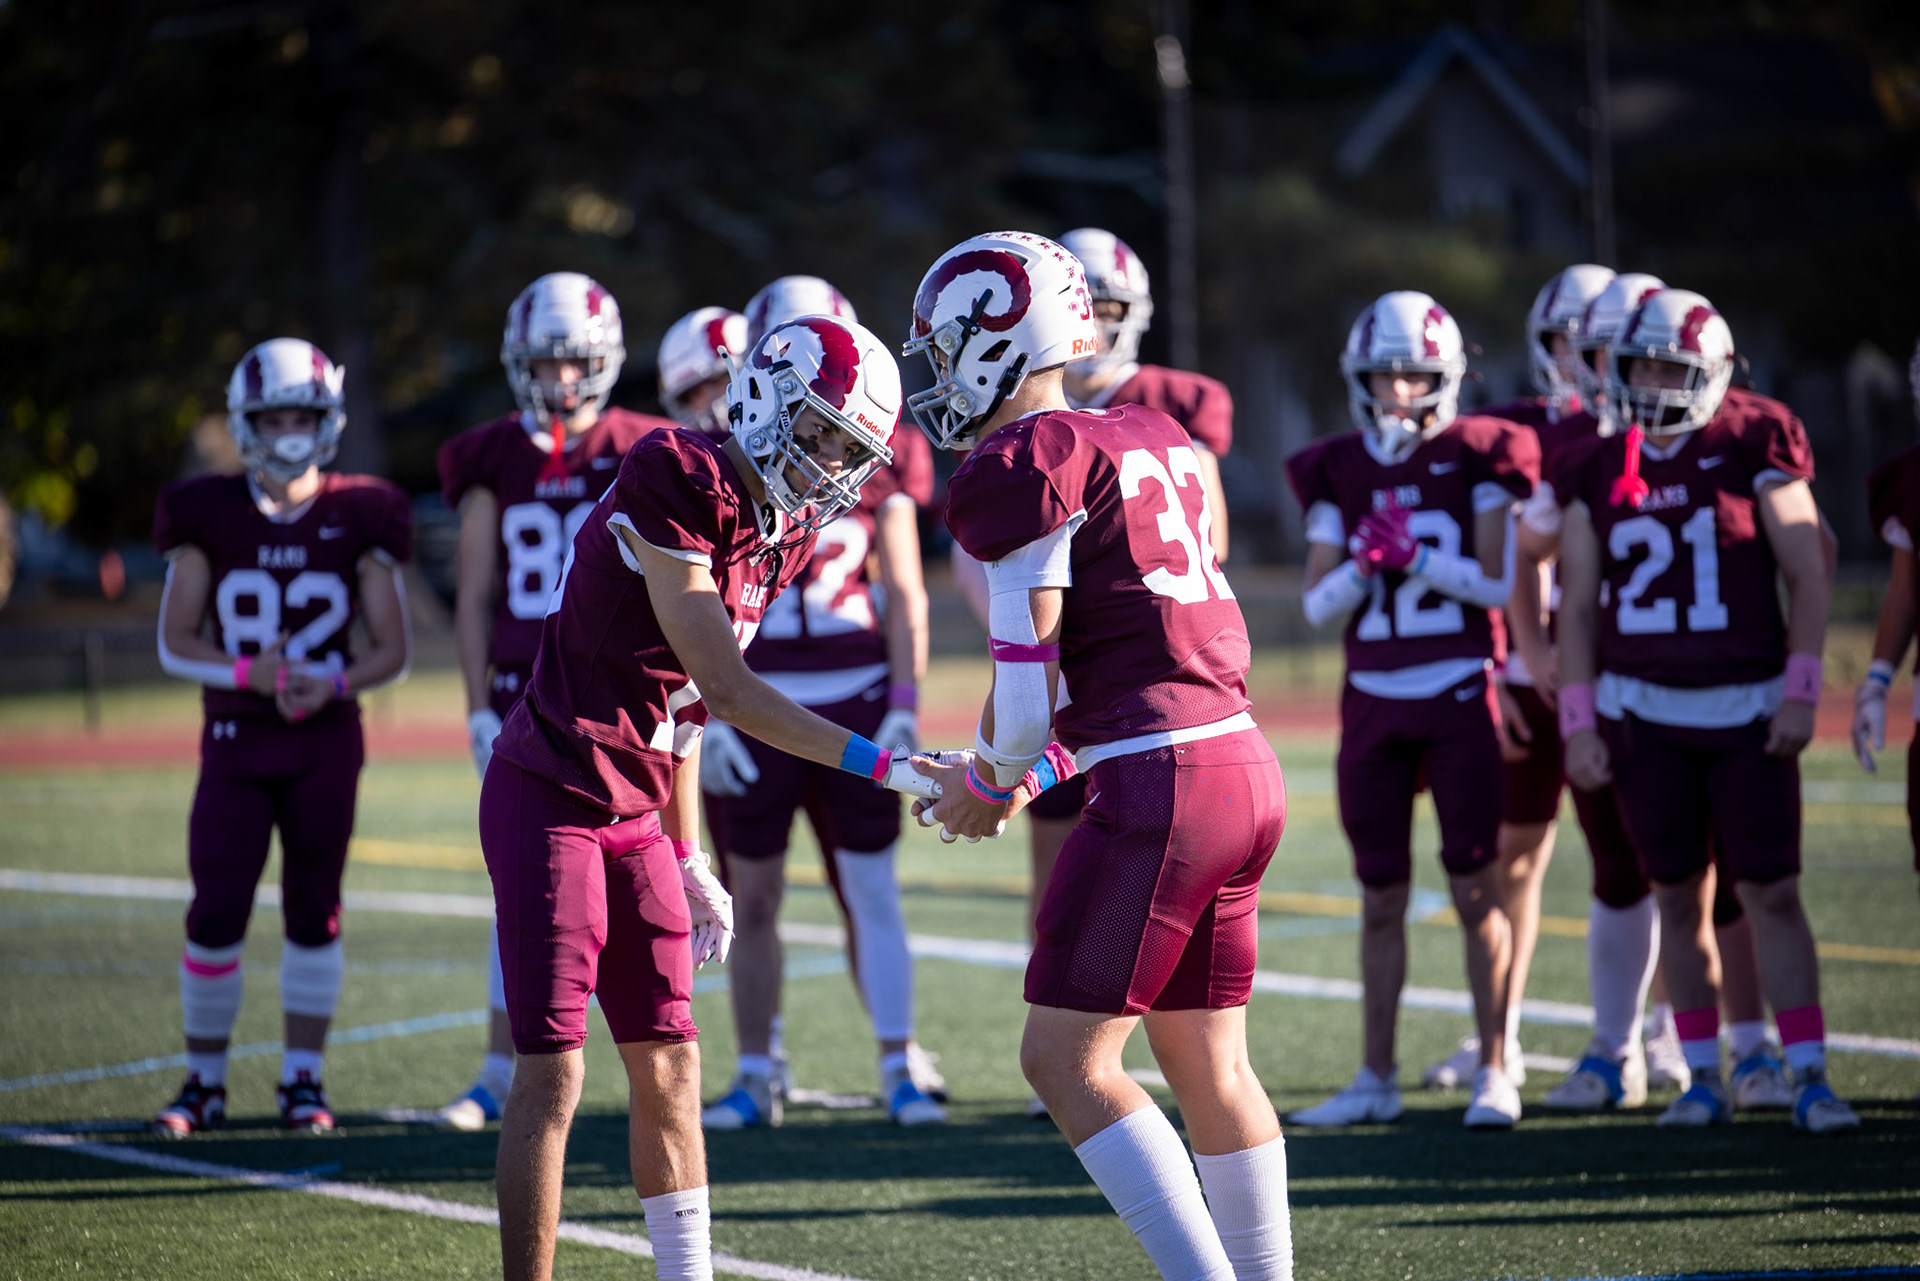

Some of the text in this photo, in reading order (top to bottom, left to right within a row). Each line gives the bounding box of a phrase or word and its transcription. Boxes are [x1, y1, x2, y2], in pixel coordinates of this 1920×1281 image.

[1075, 286, 1096, 320] 3
[856, 412, 887, 440] Riddell
[502, 501, 598, 619] 8
[1118, 446, 1236, 604] 32
[1608, 505, 1728, 635] 21
[216, 568, 349, 679] 82
